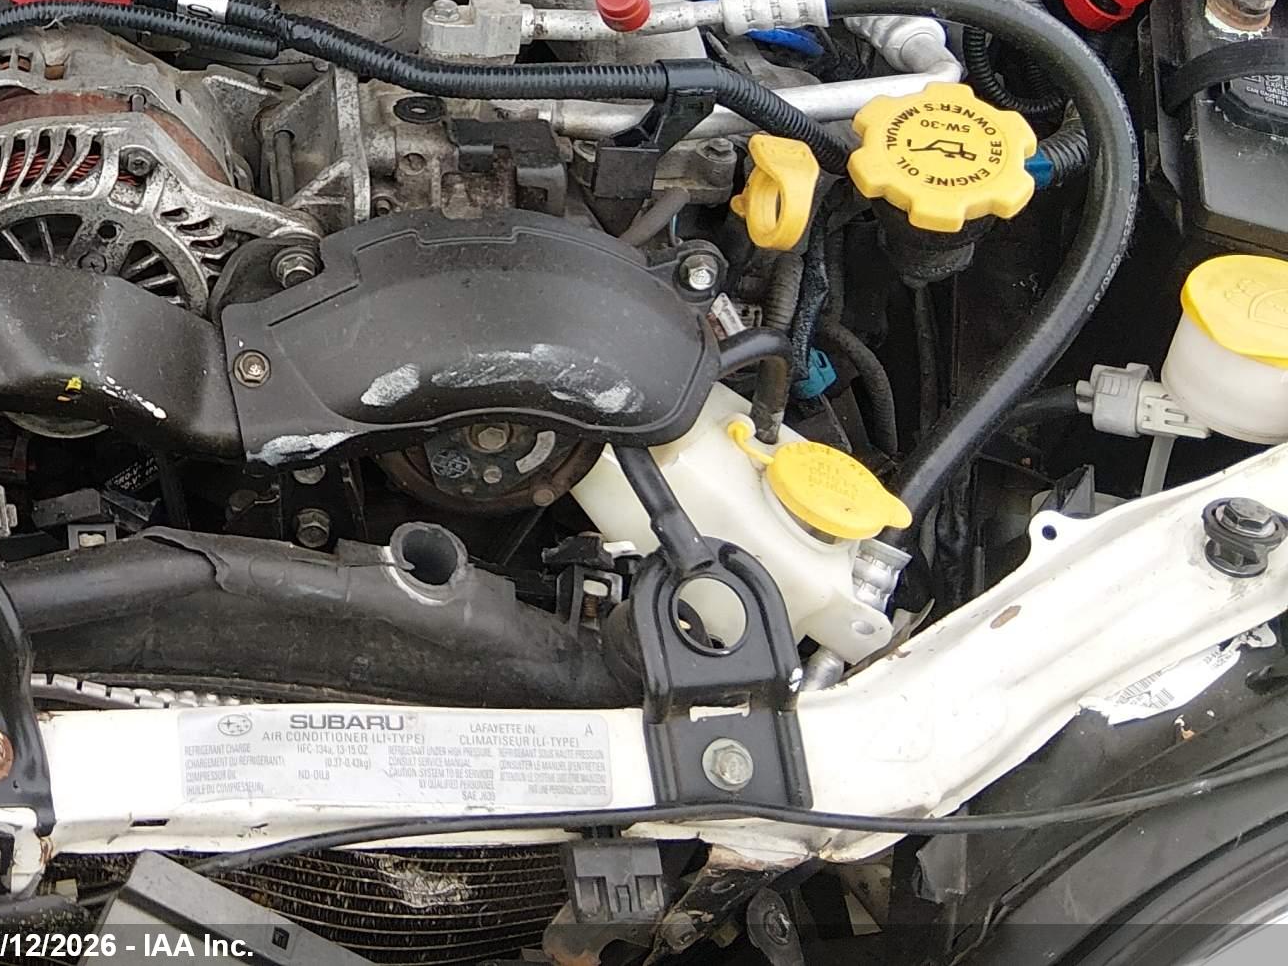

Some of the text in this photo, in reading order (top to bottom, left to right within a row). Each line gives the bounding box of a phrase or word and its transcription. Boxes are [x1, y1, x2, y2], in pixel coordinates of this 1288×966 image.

[920, 118, 970, 133] 5W-30
[885, 102, 1003, 164] SEE OWNER'S MANUAL
[896, 156, 991, 187] ENGINE OIL
[290, 714, 404, 731] SUBARU
[470, 723, 536, 734] LAFAYETTE IN
[585, 725, 594, 736] A
[262, 733, 282, 742] AIR
[285, 733, 368, 743] CONDITIONER
[459, 735, 530, 746] CLIMATISEUR
[462, 791, 477, 801] SAE
